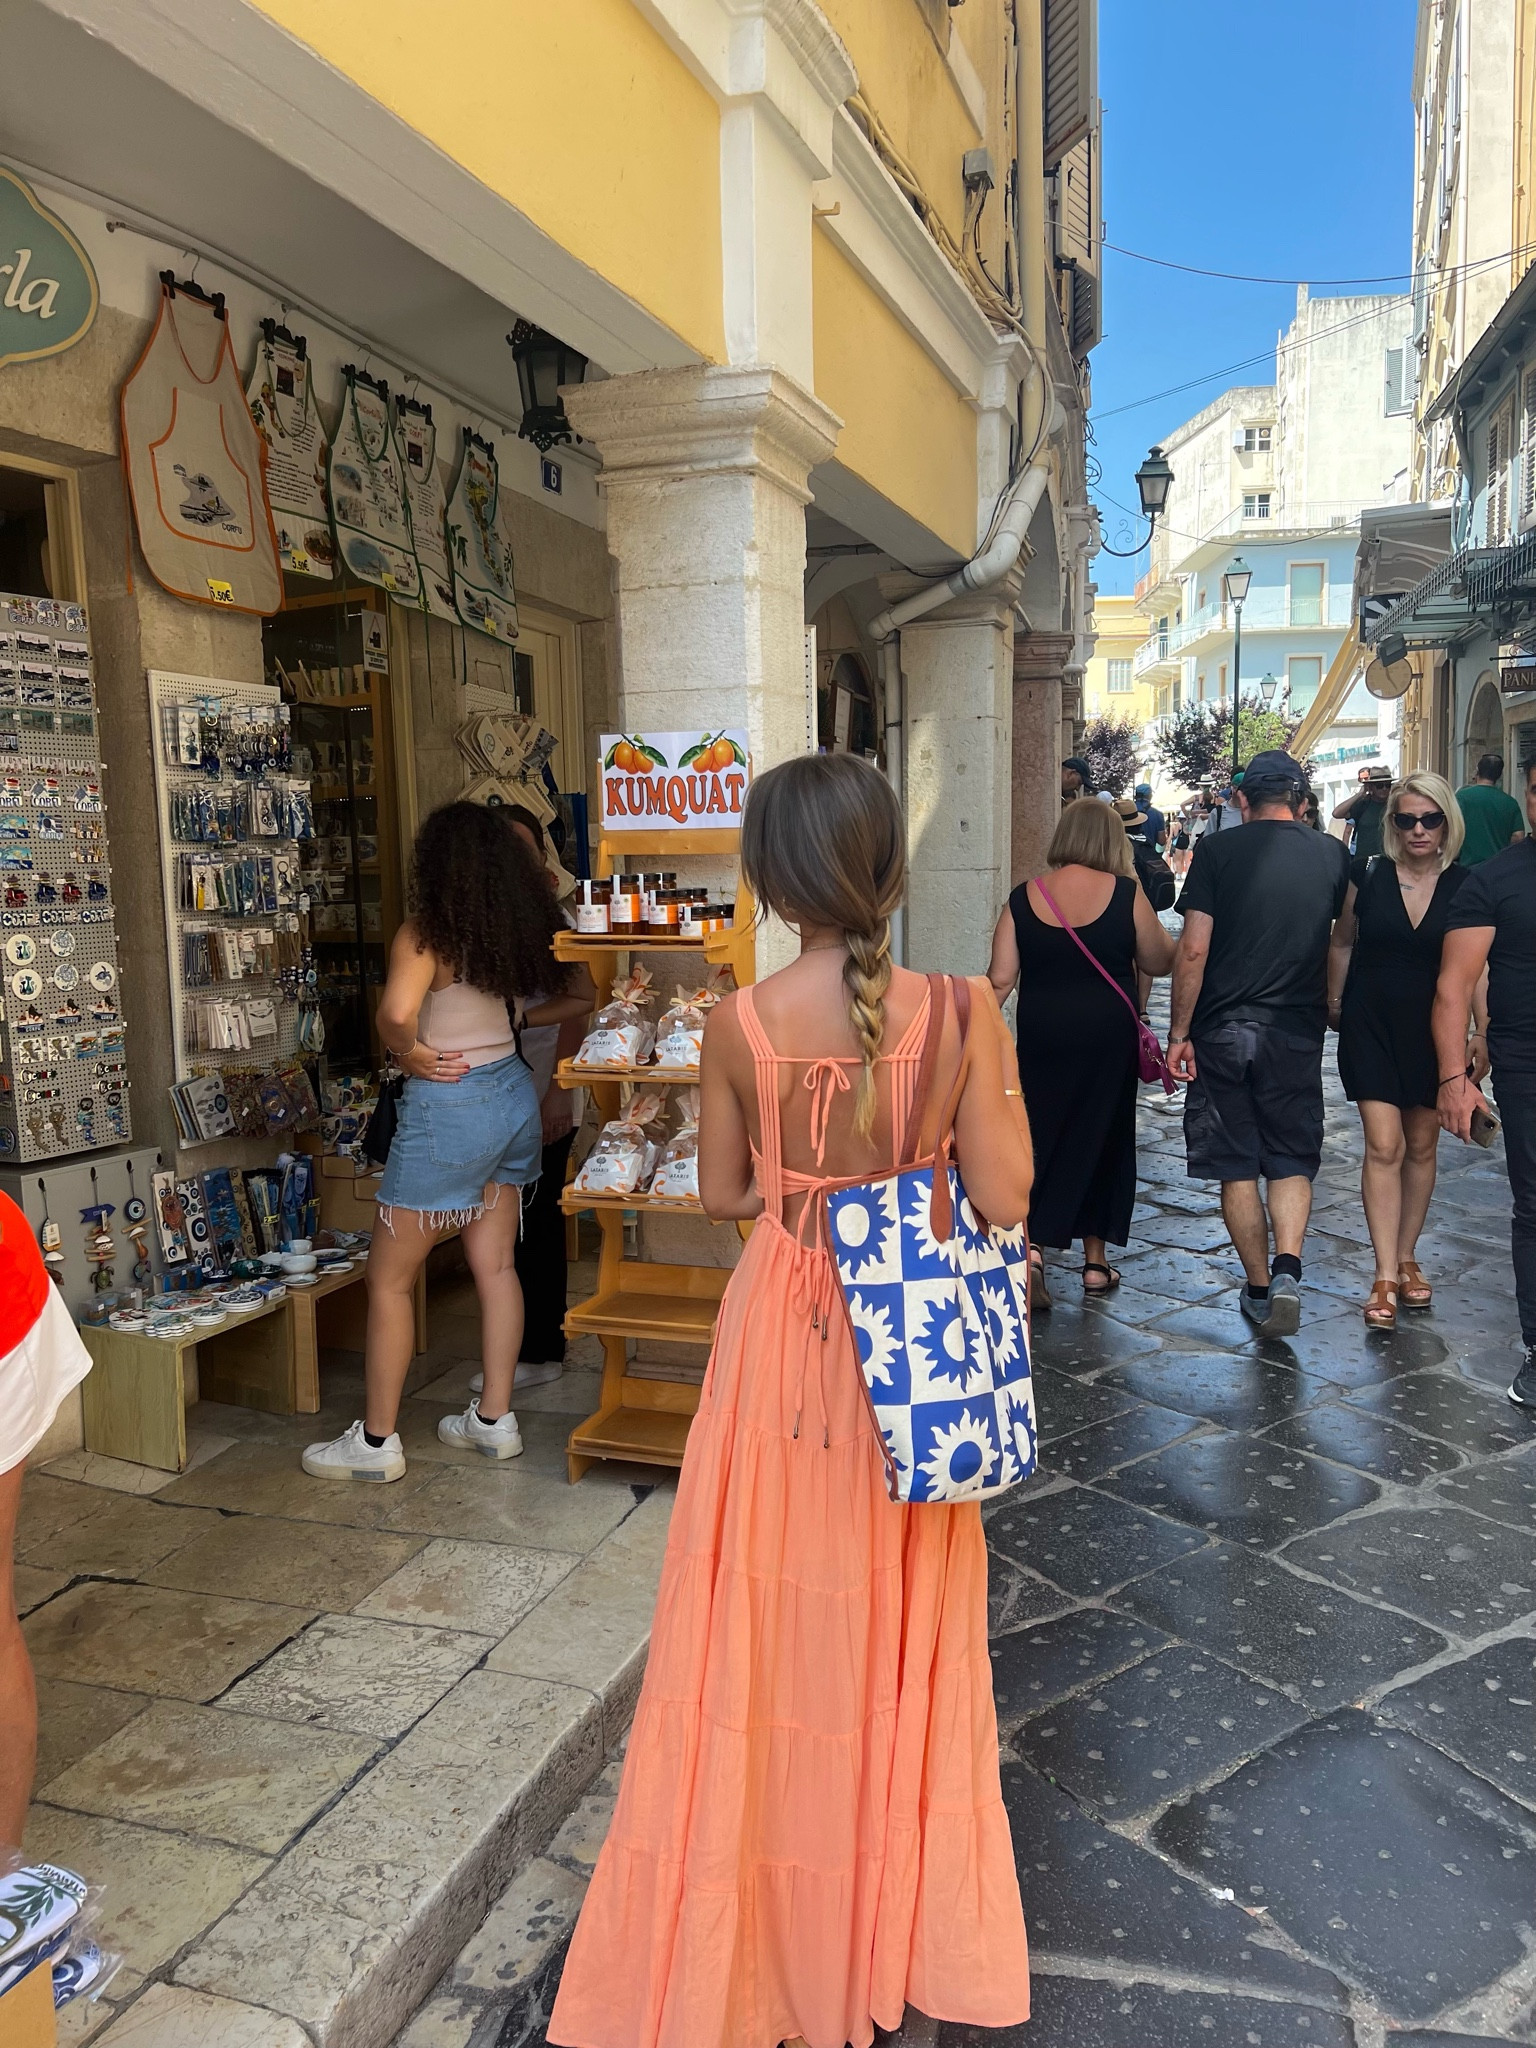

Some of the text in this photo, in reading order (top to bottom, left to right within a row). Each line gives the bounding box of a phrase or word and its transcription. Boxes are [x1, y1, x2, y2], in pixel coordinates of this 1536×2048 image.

[550, 465, 557, 488] 6
[222, 522, 243, 535] CORFU
[605, 773, 745, 824] KUMQUAT
